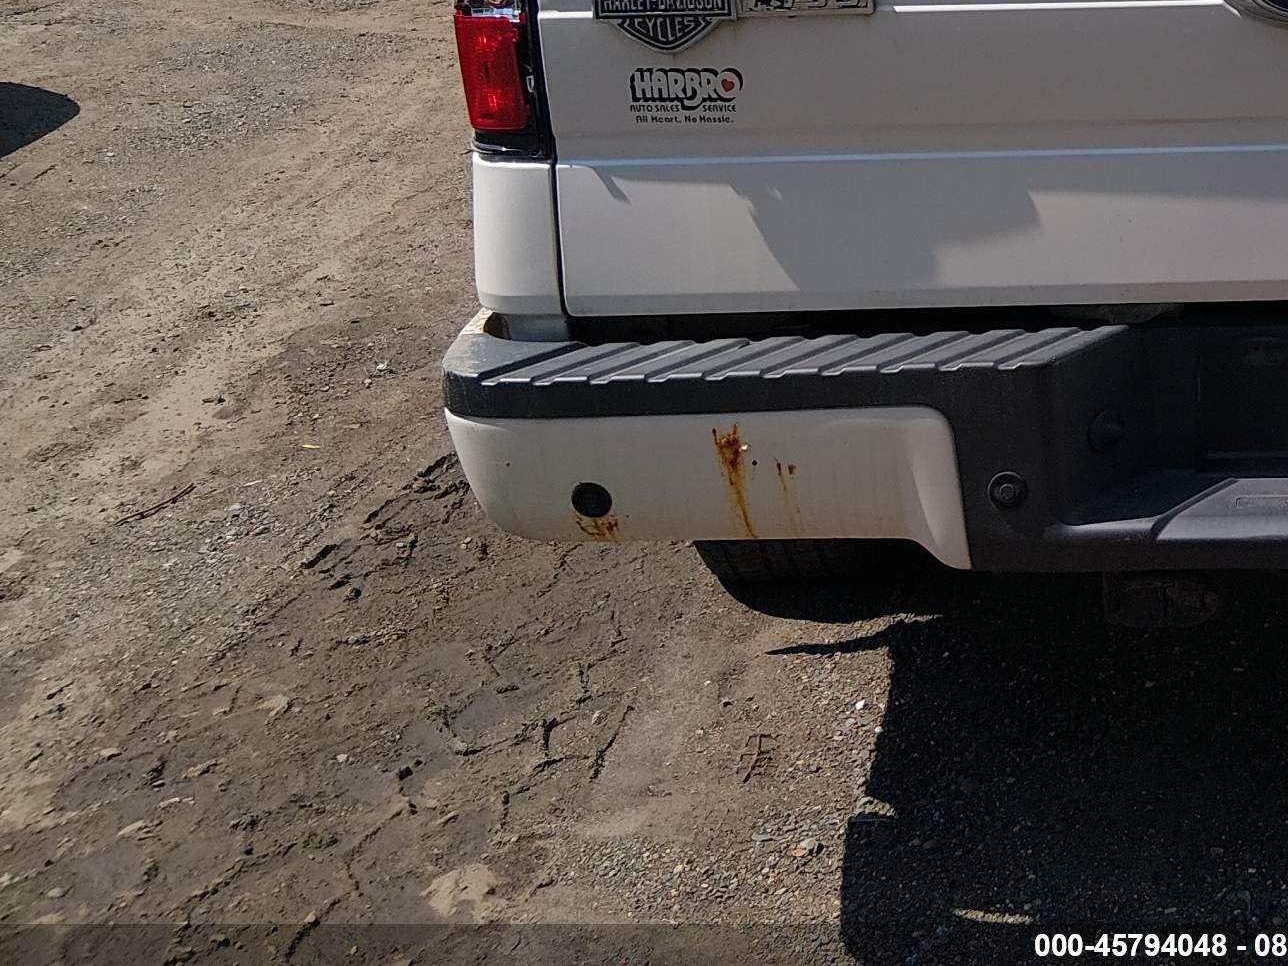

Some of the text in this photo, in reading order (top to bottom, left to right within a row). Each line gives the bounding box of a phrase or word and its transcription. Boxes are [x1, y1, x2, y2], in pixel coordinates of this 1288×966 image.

[634, 17, 695, 41] CYCLES
[629, 68, 744, 110] HARBRO
[630, 104, 737, 112] AUTO SALES SERVICE
[685, 114, 698, 123] No
